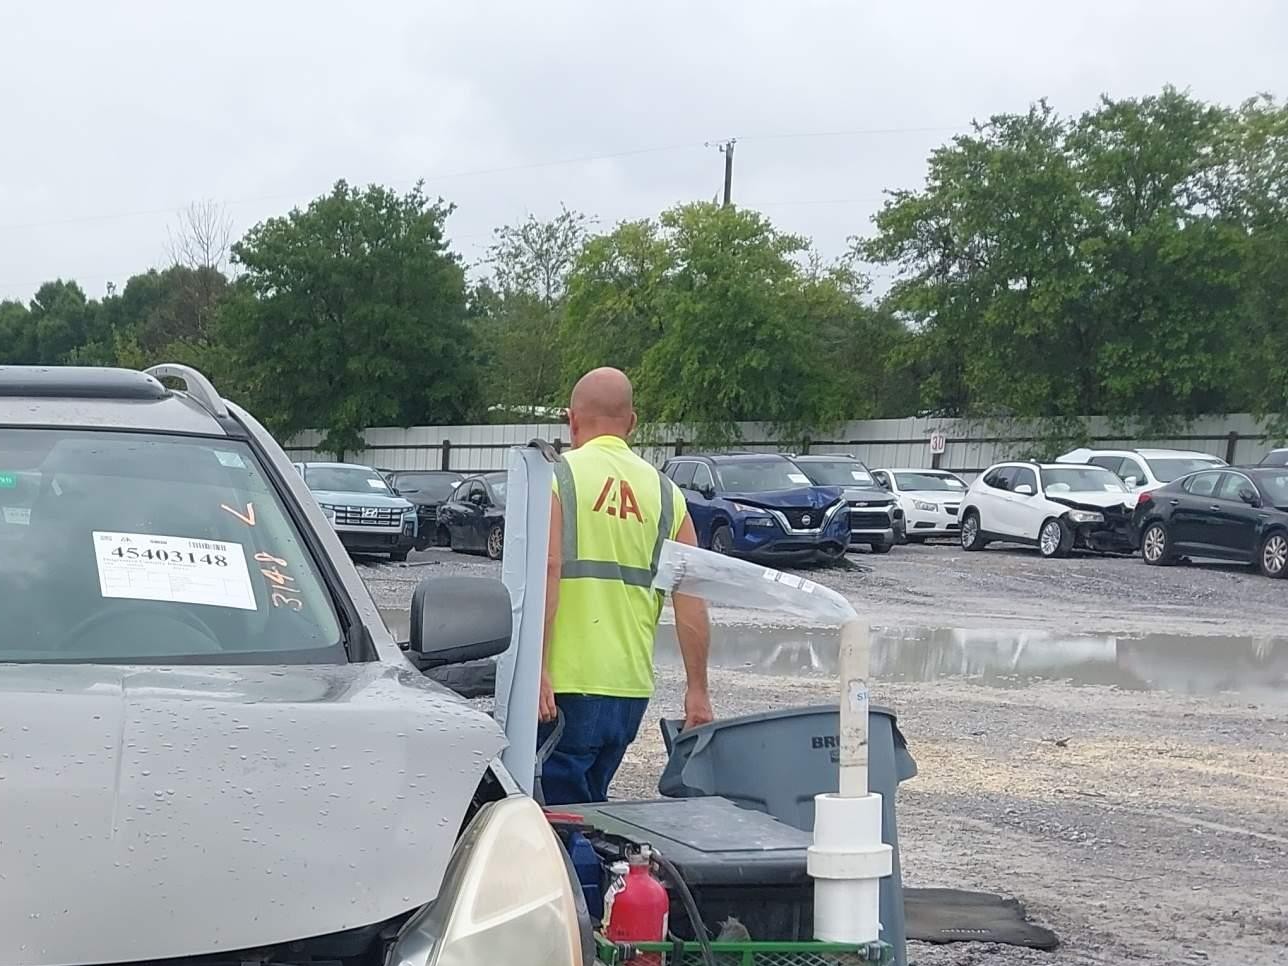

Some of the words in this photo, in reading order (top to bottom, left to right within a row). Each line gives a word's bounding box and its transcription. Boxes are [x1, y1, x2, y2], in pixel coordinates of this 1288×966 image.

[932, 435, 944, 450] 30
[111, 546, 228, 568] 45403148
[254, 551, 303, 611] 3148
